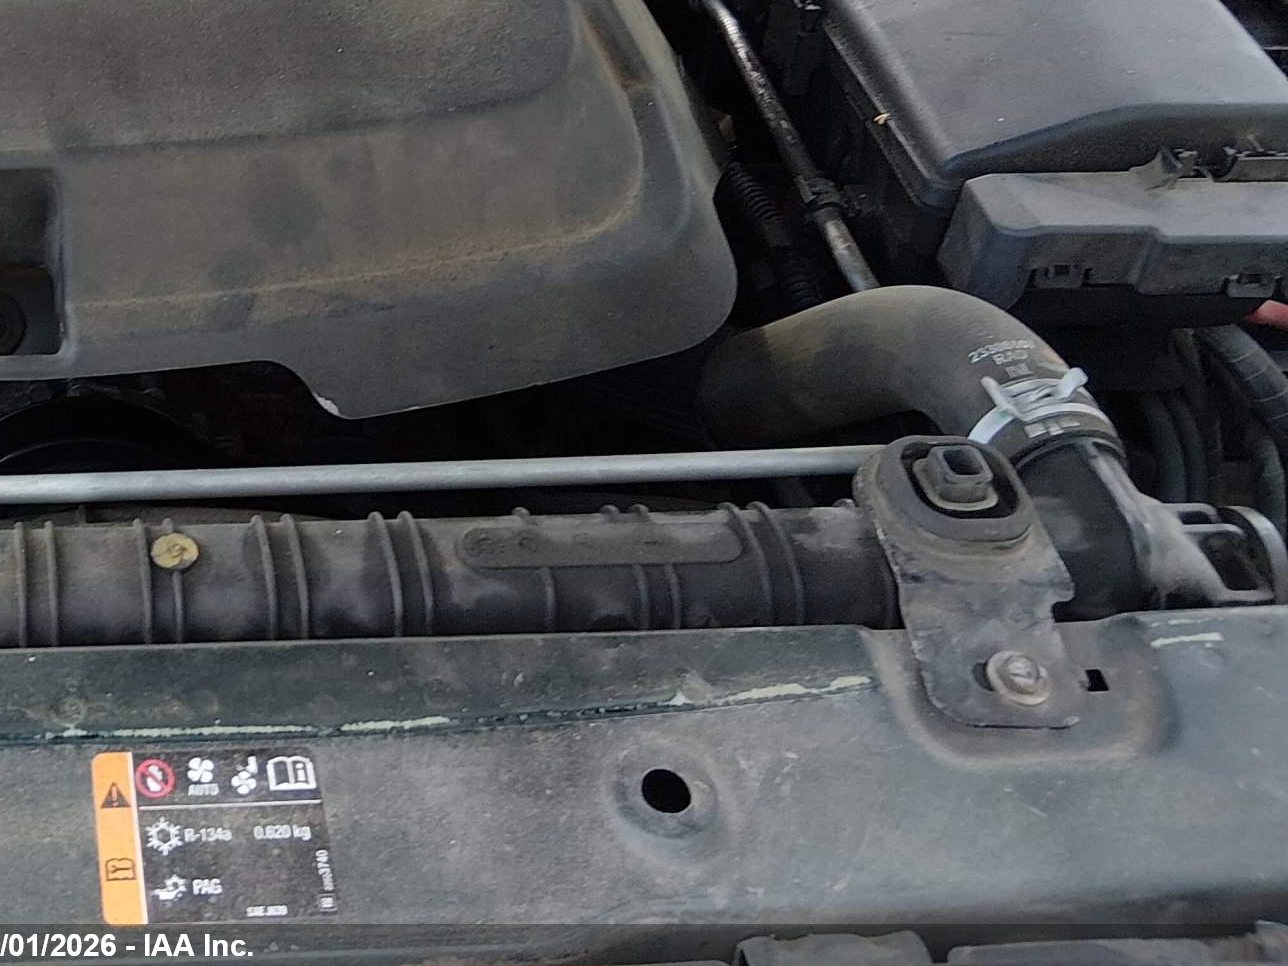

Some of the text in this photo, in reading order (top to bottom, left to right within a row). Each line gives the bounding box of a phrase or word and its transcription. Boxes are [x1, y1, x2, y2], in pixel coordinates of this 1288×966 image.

[184, 828, 232, 842] R-134a
[292, 825, 311, 841] kg
[192, 879, 223, 895] PAG
